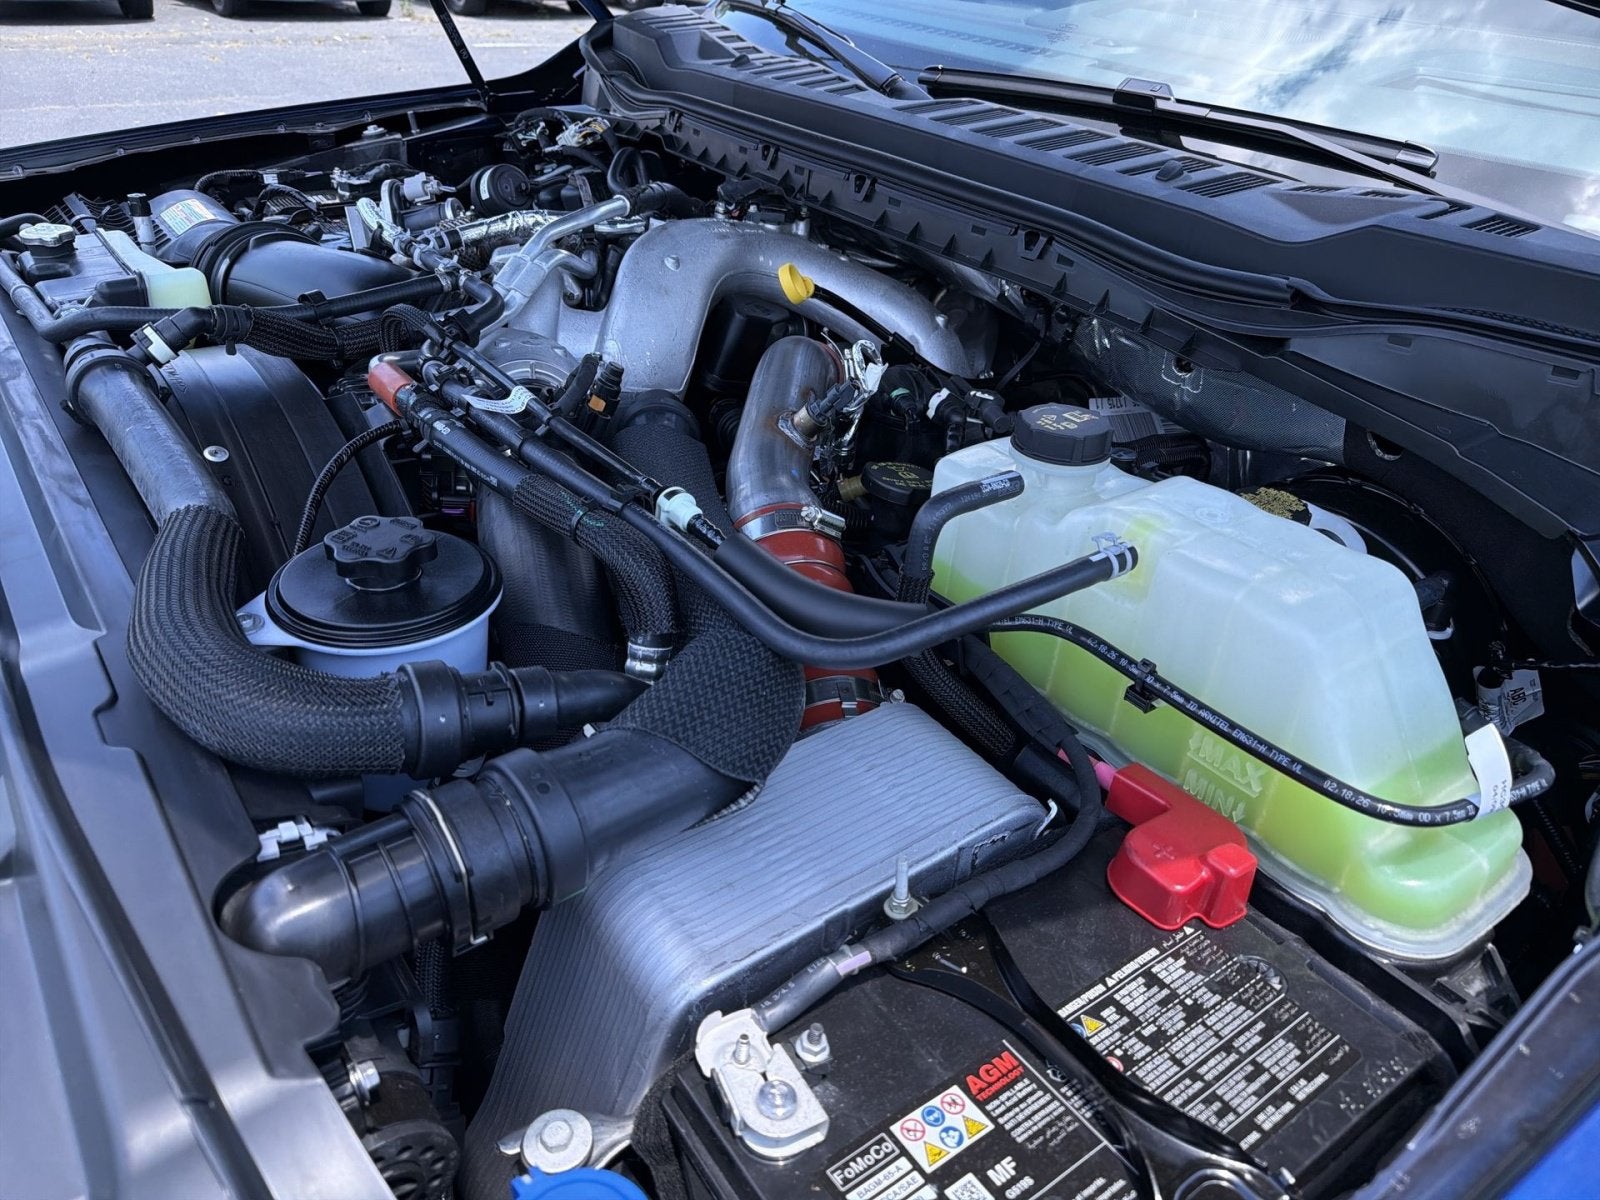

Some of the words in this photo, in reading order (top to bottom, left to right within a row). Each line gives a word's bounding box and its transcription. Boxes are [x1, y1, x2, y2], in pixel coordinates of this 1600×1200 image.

[1509, 686, 1527, 706] ABC
[1197, 707, 1230, 732] ARNITEL
[1267, 748, 1291, 767] TYPE
[1199, 732, 1264, 792] MAX
[1417, 812, 1431, 822] OD
[964, 1049, 1019, 1094] AGM
[975, 1065, 1025, 1101] TECHNOLOGY
[833, 1138, 894, 1185] FoMoCo
[986, 1154, 1016, 1186] MF
[856, 1165, 903, 1199] BAGM-65-A
